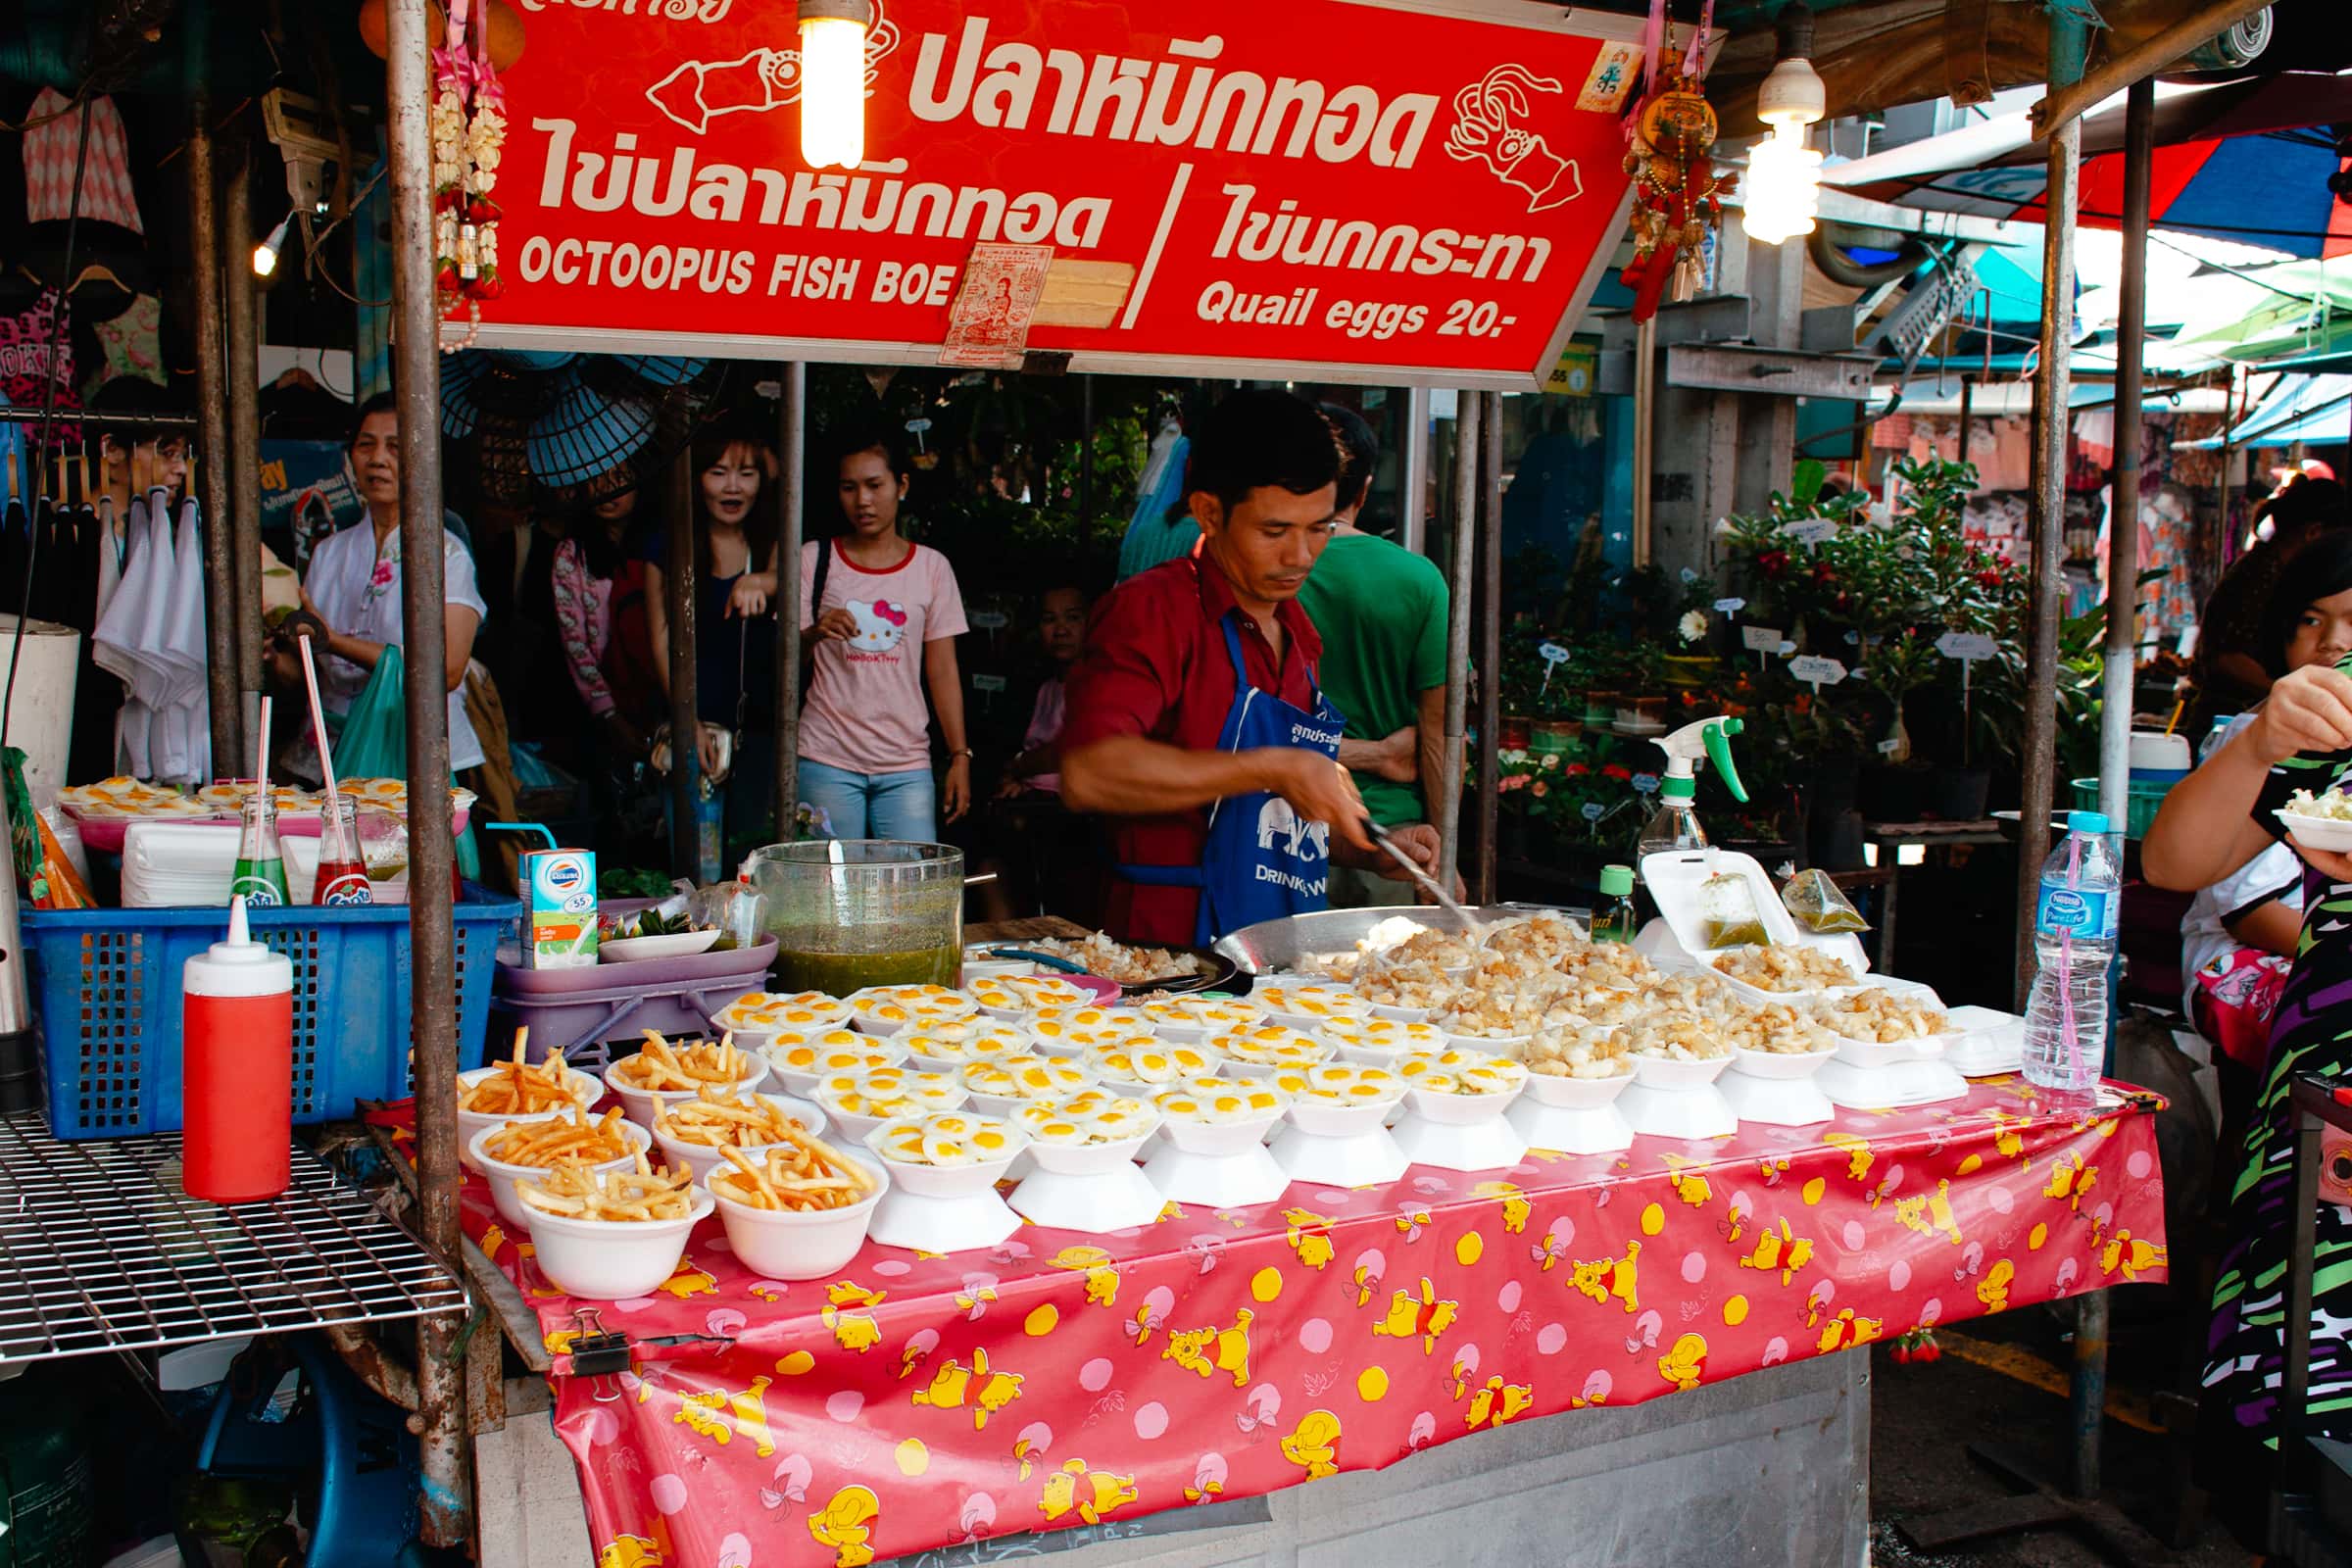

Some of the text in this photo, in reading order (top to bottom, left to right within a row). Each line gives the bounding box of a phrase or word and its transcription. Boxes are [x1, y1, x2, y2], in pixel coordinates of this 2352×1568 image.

[909, 17, 1441, 170] ปลาหมึกทอด
[531, 118, 1112, 249] ไข่ปลาหมึกทอด
[1212, 183, 1551, 282] ไข่นกกระทา
[519, 235, 756, 295] OCTOOPUS
[767, 254, 861, 301] FISH
[1197, 280, 1319, 326] Quail
[1325, 300, 1429, 339] eggs
